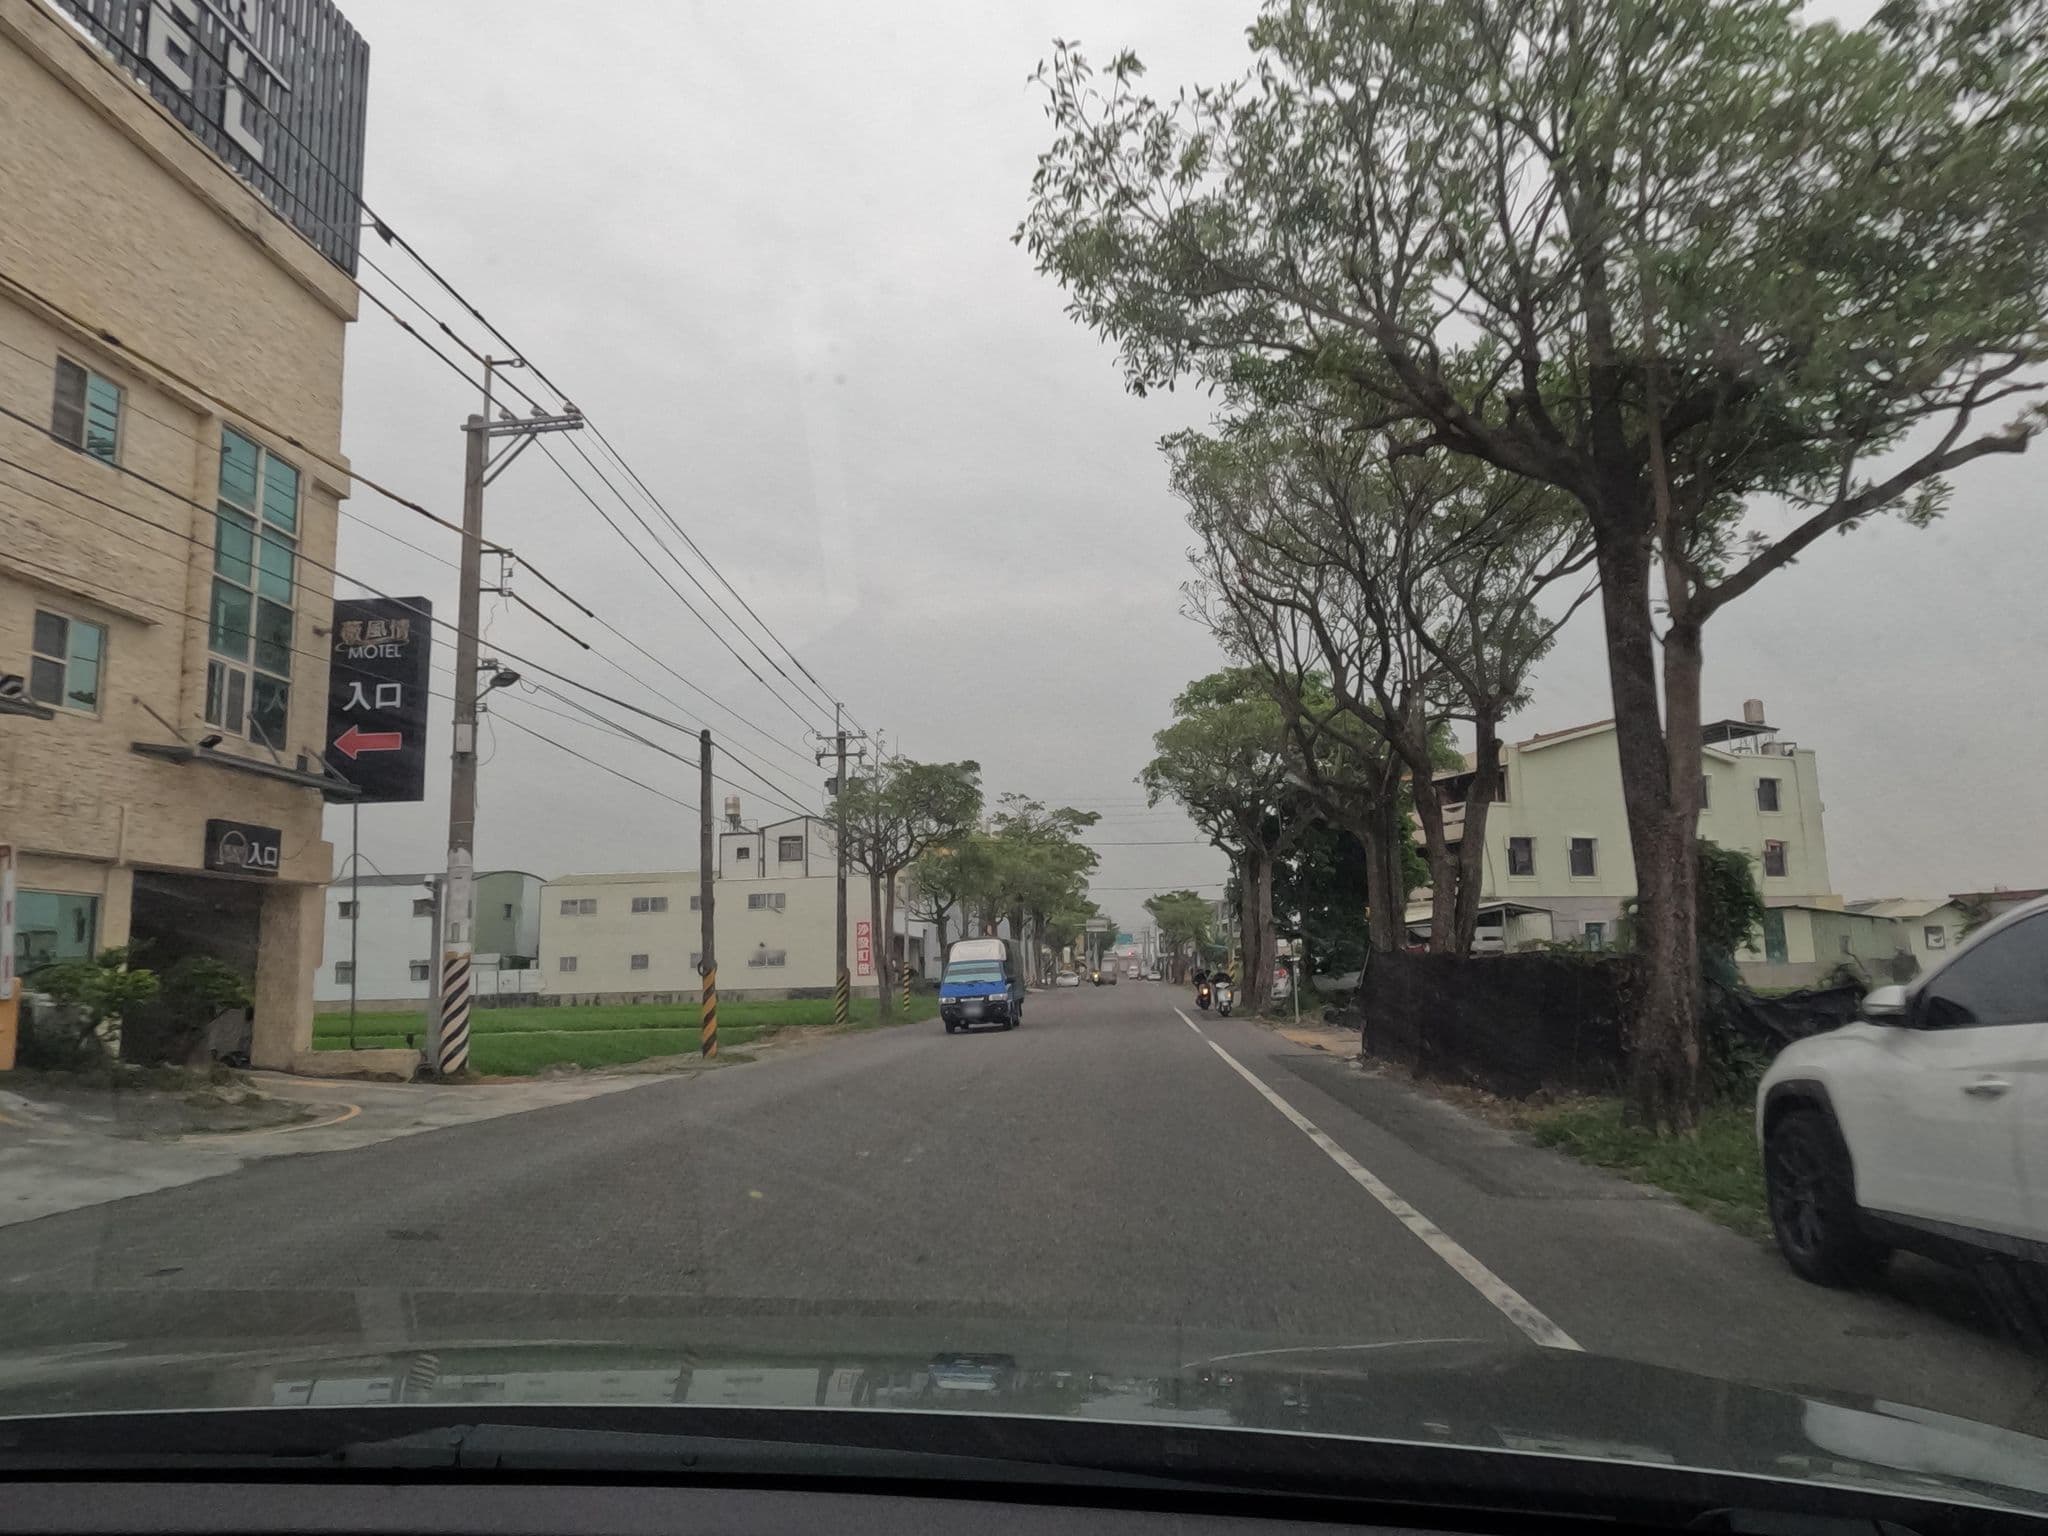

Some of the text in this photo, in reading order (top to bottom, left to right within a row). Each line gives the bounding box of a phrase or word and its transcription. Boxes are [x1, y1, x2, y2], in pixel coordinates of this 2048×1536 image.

[348, 643, 402, 660] MOTEL
[342, 681, 402, 711] 入口
[247, 842, 278, 867] 入口
